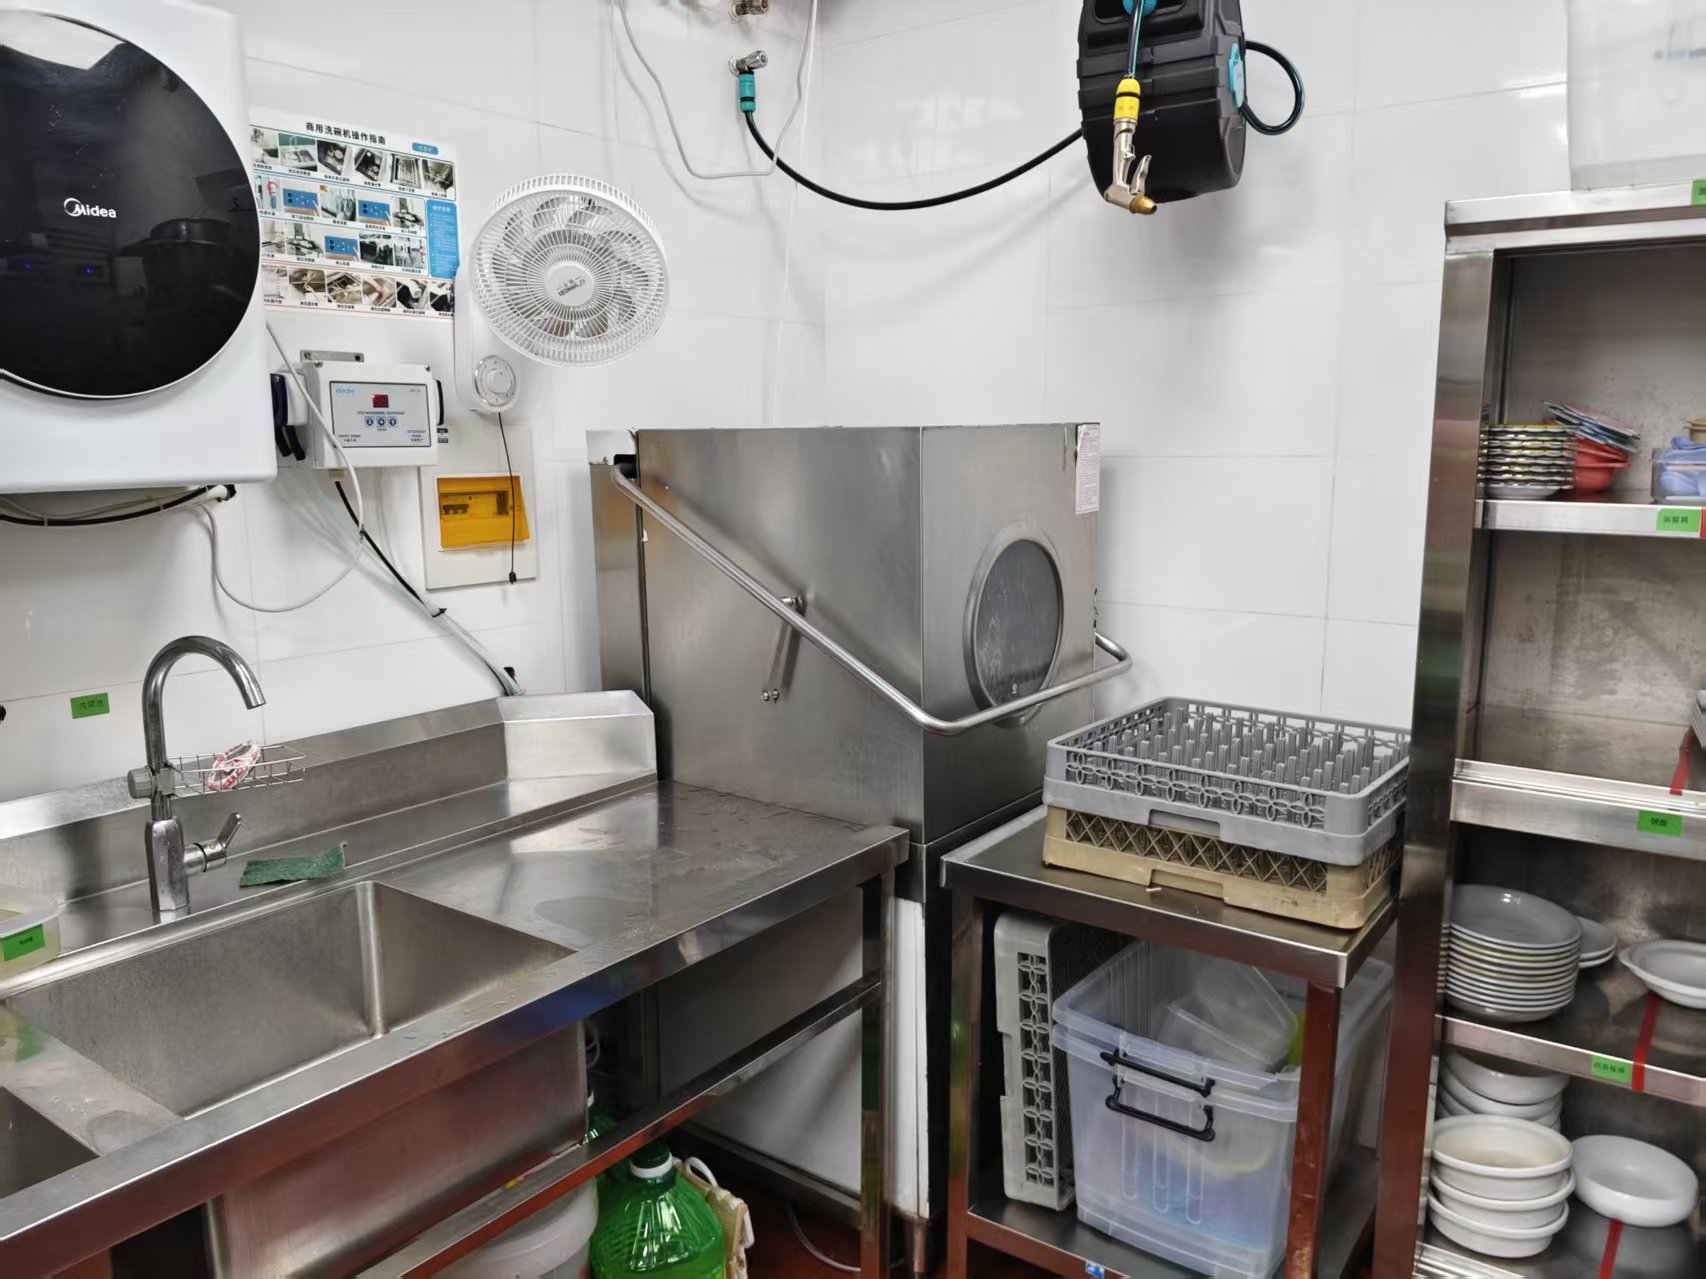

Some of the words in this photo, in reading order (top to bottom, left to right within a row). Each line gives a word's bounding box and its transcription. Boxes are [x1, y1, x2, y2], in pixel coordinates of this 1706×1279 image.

[306, 121, 386, 145] 商用洗碗机操作指南
[63, 197, 117, 219] Midea
